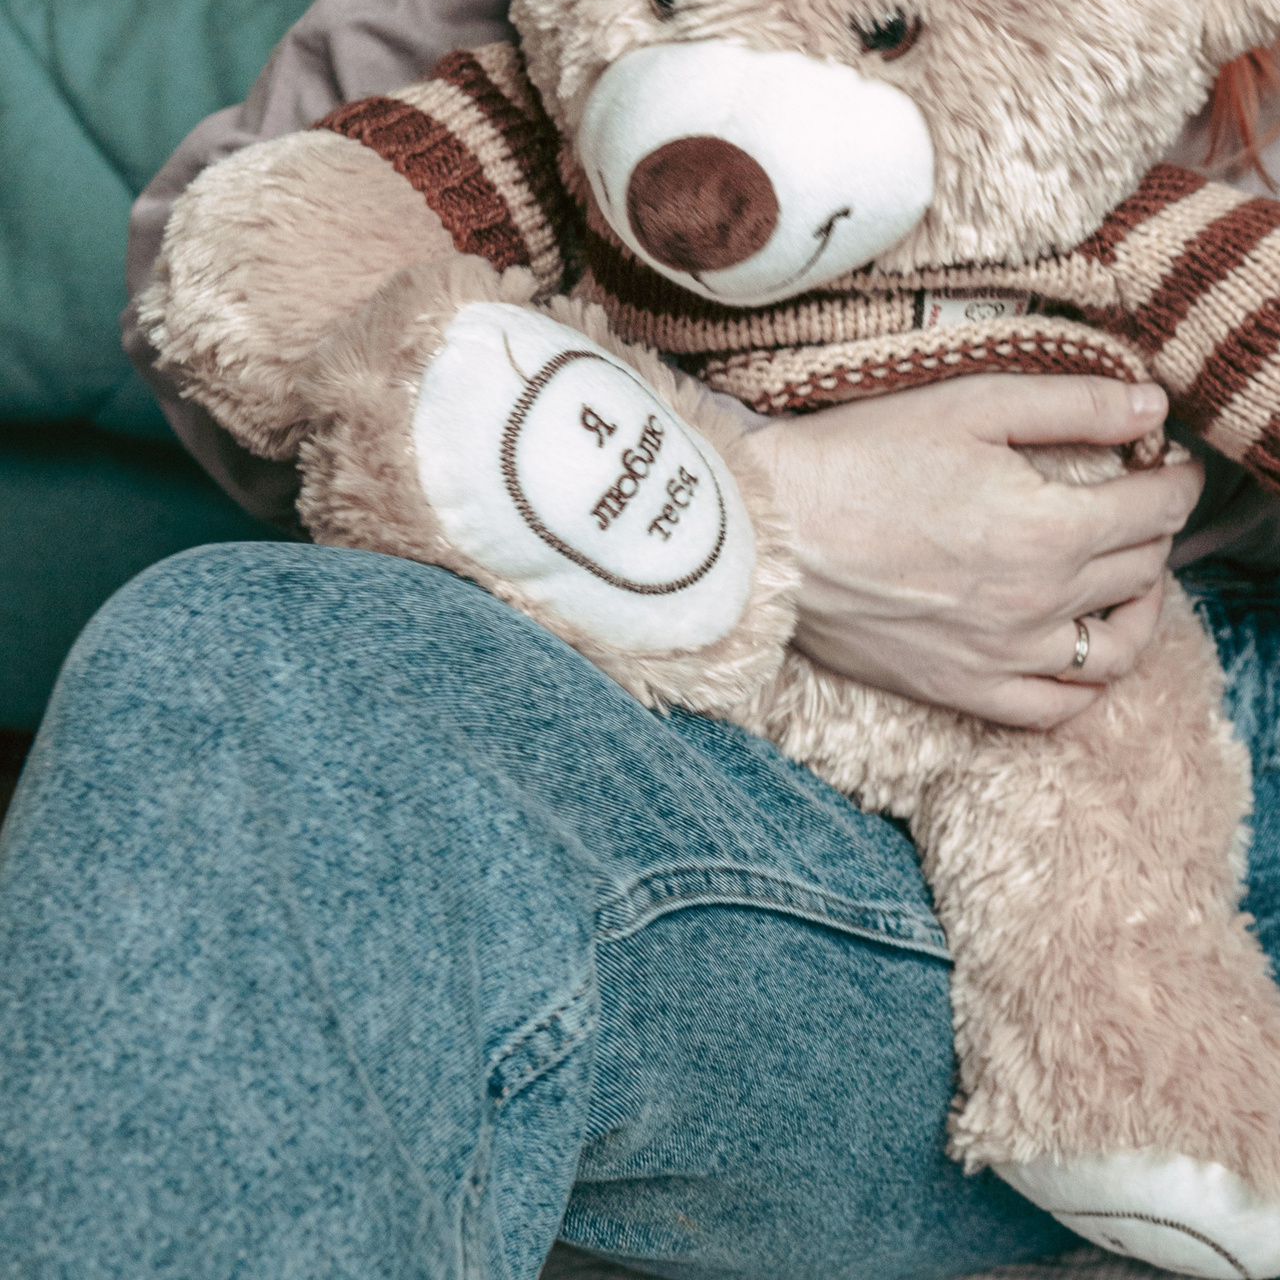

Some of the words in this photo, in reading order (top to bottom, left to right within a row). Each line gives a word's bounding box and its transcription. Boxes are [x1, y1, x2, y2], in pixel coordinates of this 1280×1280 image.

[580, 403, 617, 448] Я
[590, 414, 664, 531] люблю
[647, 466, 699, 541] тебя
